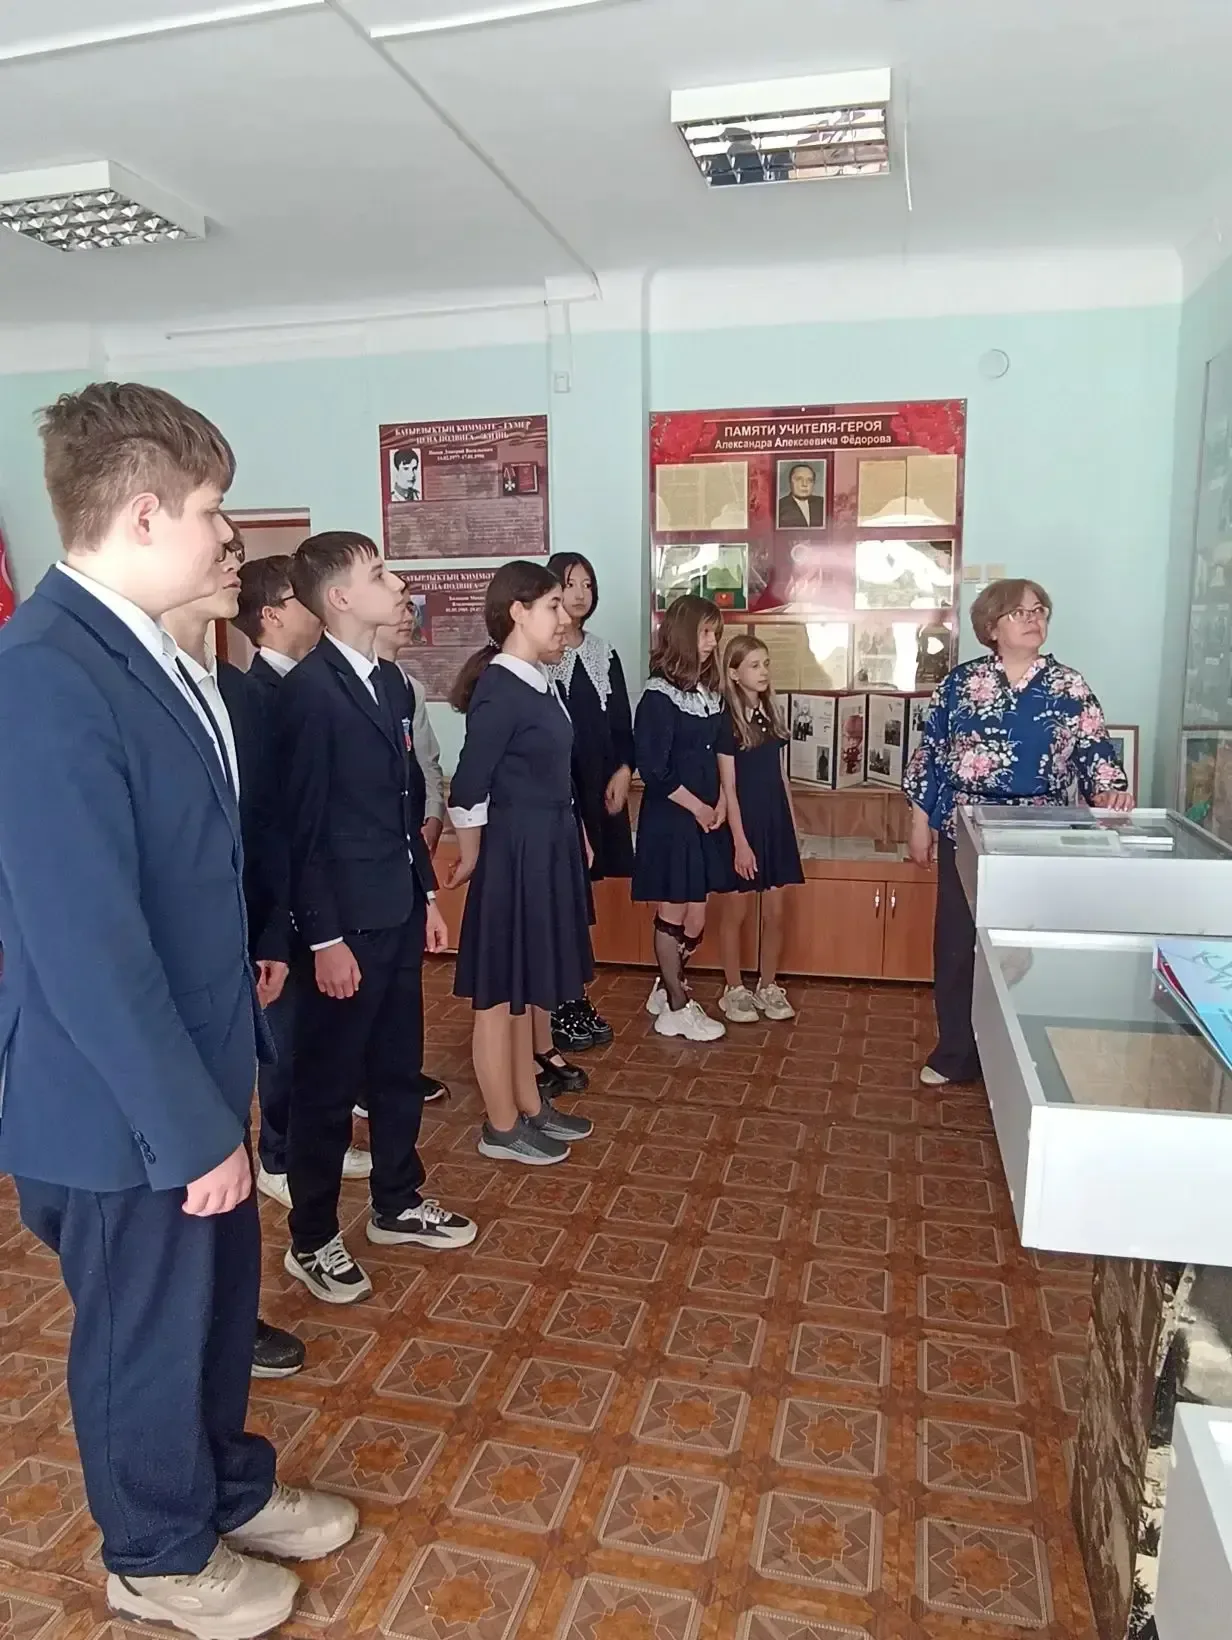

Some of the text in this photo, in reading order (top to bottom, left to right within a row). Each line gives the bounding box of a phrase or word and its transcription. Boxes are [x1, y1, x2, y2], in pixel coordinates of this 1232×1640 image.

[724, 420, 882, 437] ПАМЯТИ УЧИТЕЛЯ-ГЕРОЯ
[715, 434, 892, 450] Александра Алексеевича Фёдорова
